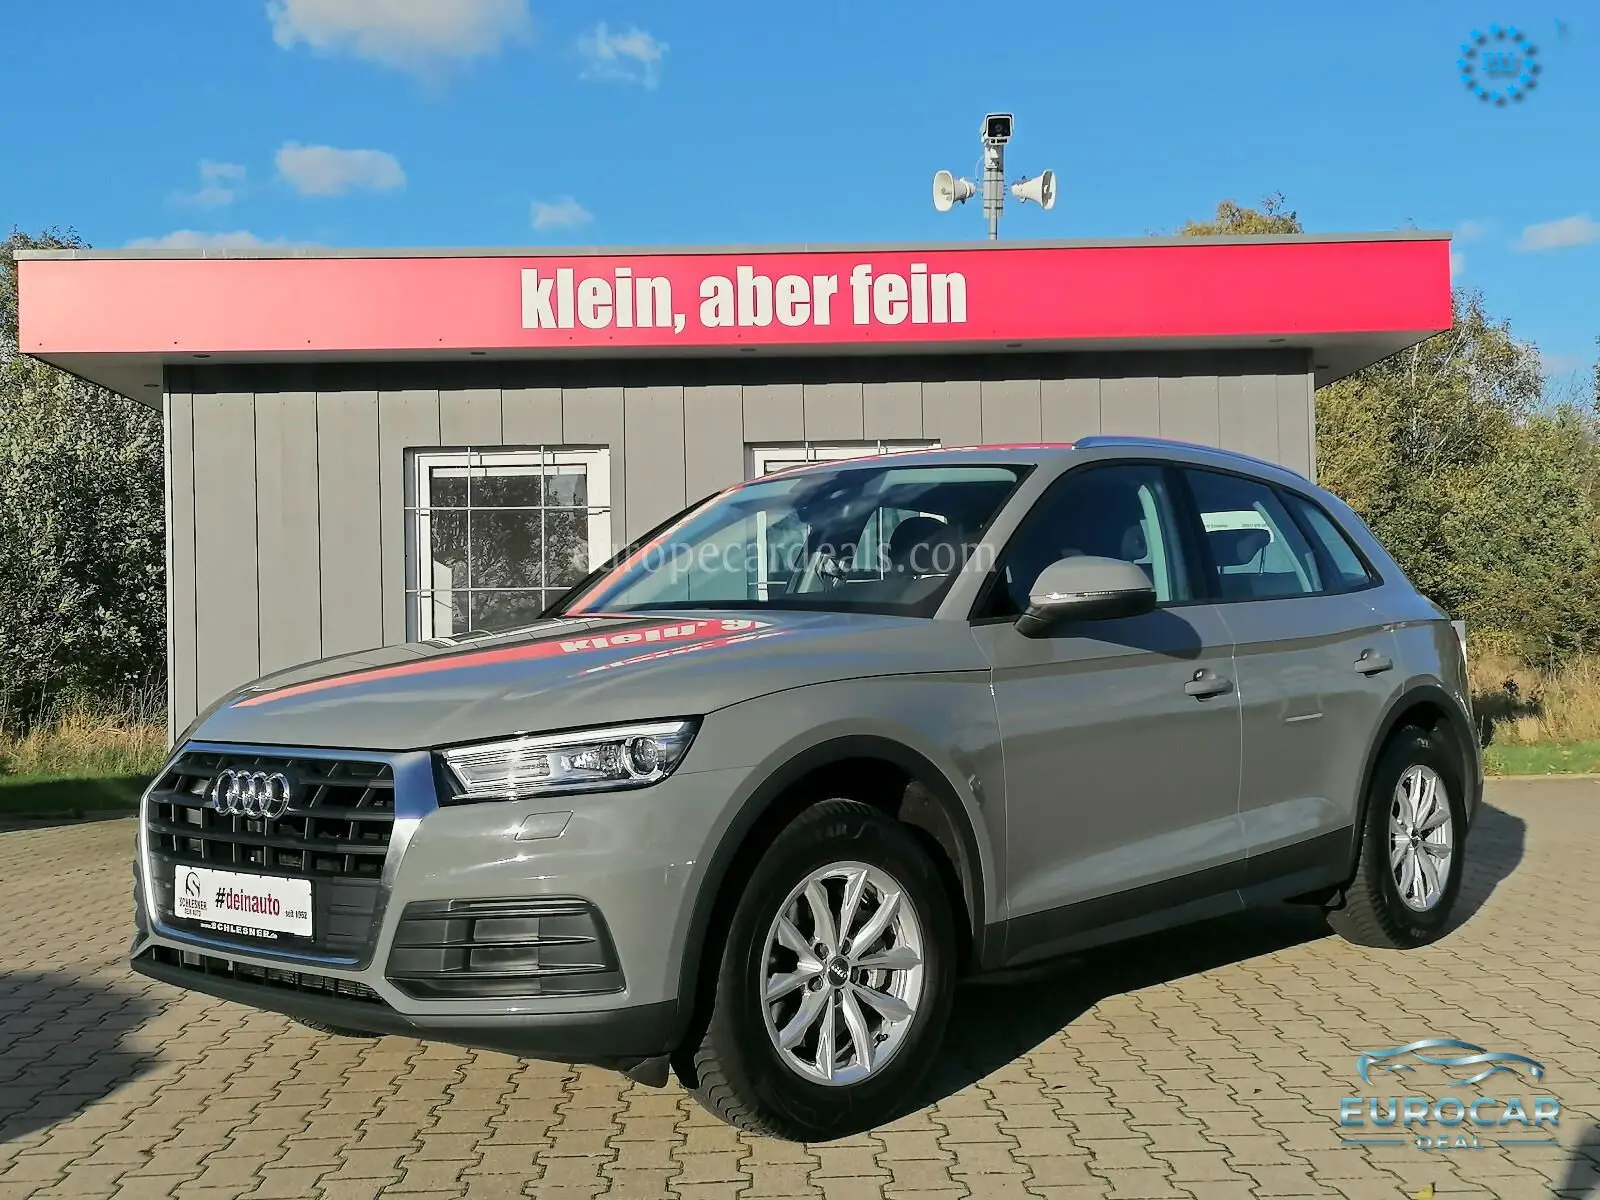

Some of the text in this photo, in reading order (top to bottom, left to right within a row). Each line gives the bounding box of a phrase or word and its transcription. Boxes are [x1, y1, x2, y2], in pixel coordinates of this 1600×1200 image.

[521, 263, 967, 335] klein, aber fein
[215, 887, 280, 916] #deinauto
